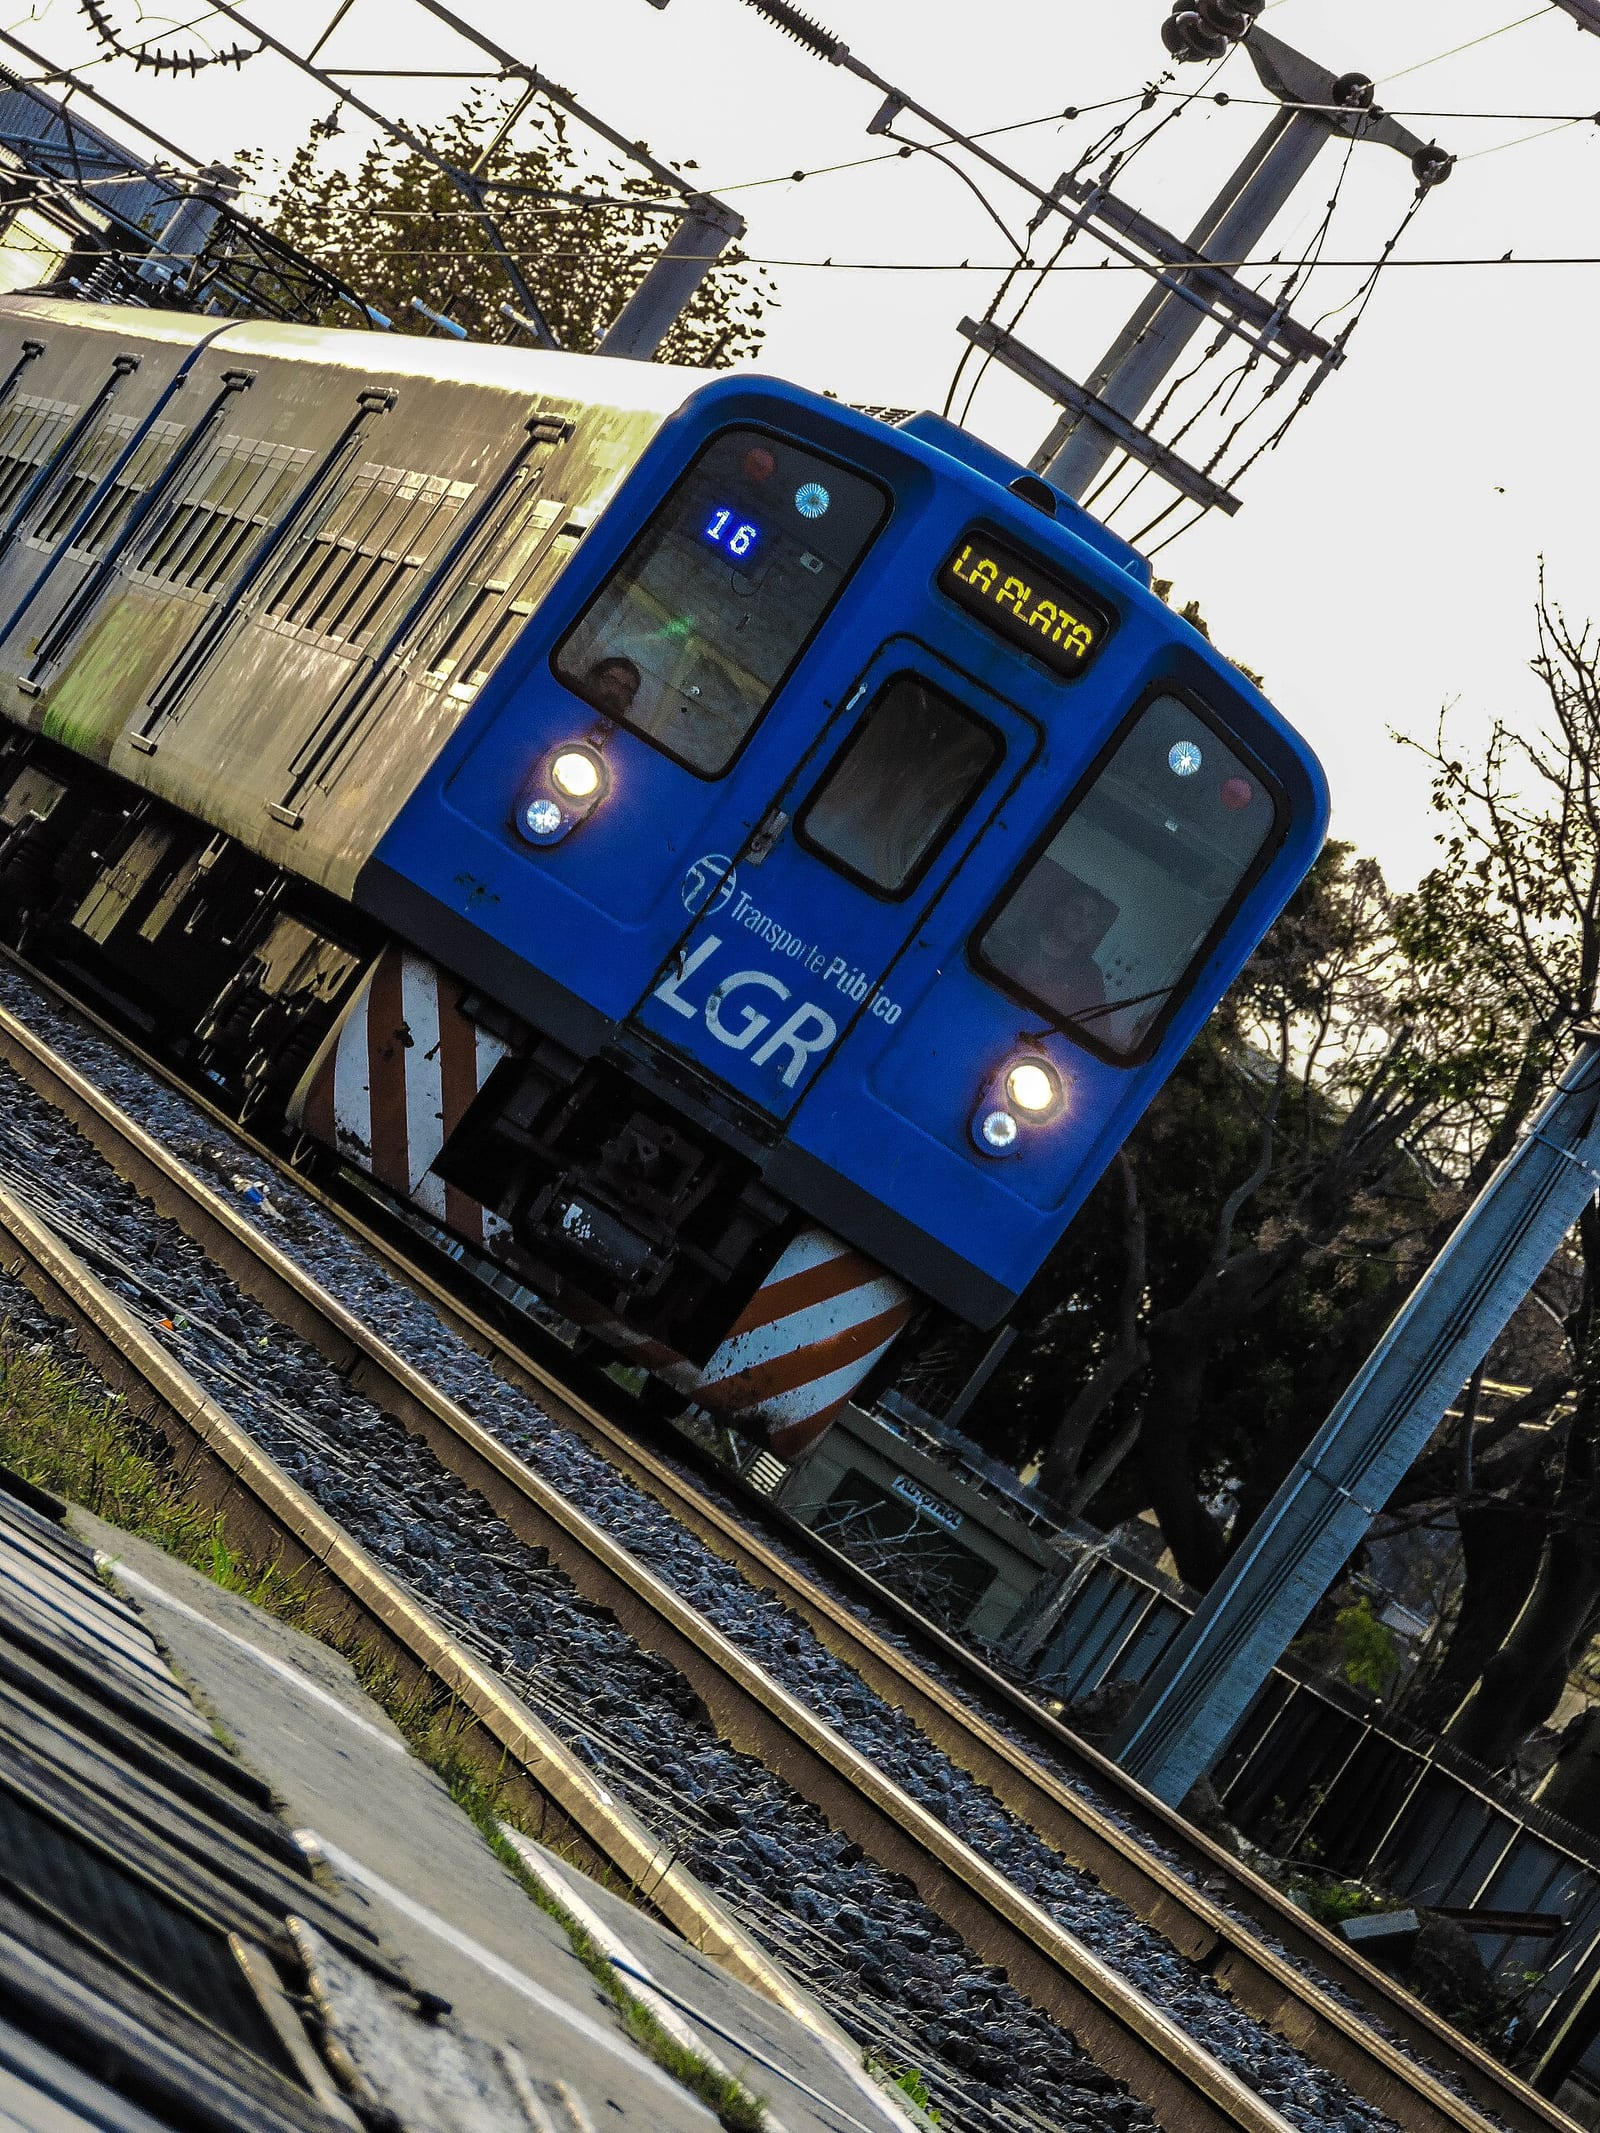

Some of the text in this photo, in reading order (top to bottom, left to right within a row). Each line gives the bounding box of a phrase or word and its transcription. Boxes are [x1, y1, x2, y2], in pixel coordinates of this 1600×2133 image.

[707, 510, 756, 554] 16
[953, 546, 1092, 657] LA PLATA
[731, 890, 826, 973] Transporte
[654, 934, 837, 1088] LGR
